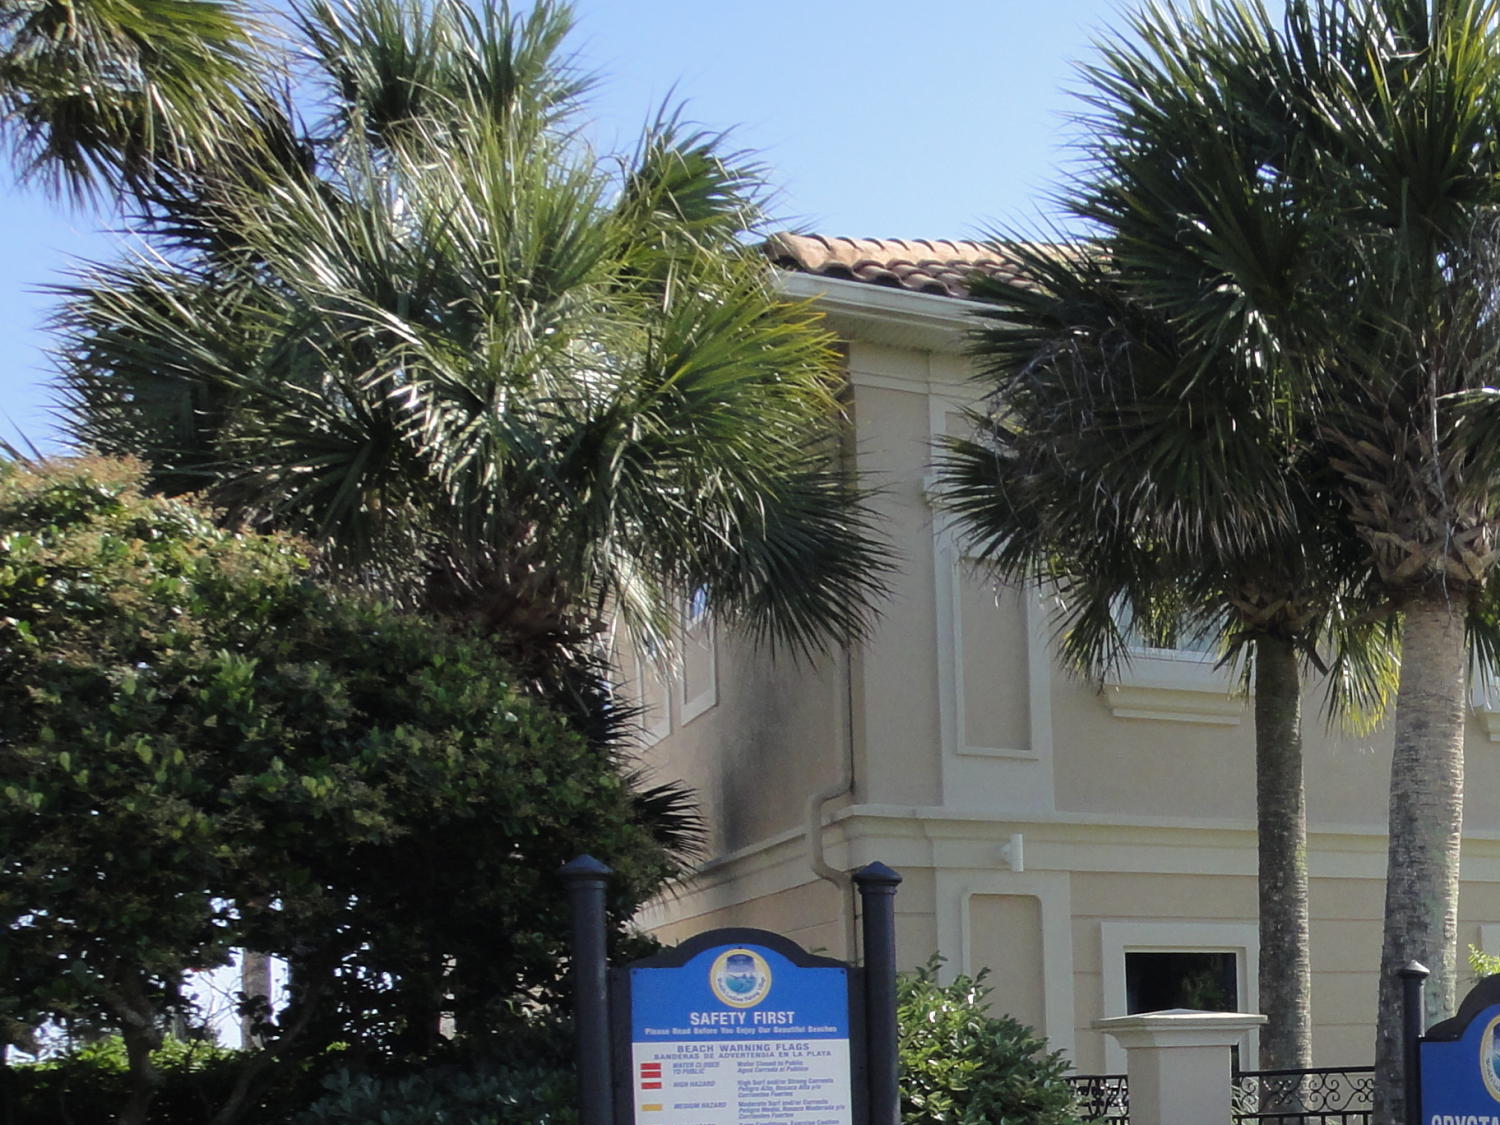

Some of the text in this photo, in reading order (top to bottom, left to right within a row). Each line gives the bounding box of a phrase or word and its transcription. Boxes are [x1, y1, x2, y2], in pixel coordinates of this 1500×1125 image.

[690, 1011, 796, 1026] SAFETY FIRST
[644, 1025, 838, 1036] Please Read Before You Enjoy Our Beautiful Beaches
[677, 1042, 811, 1053] BEACH WARNING FLAGS
